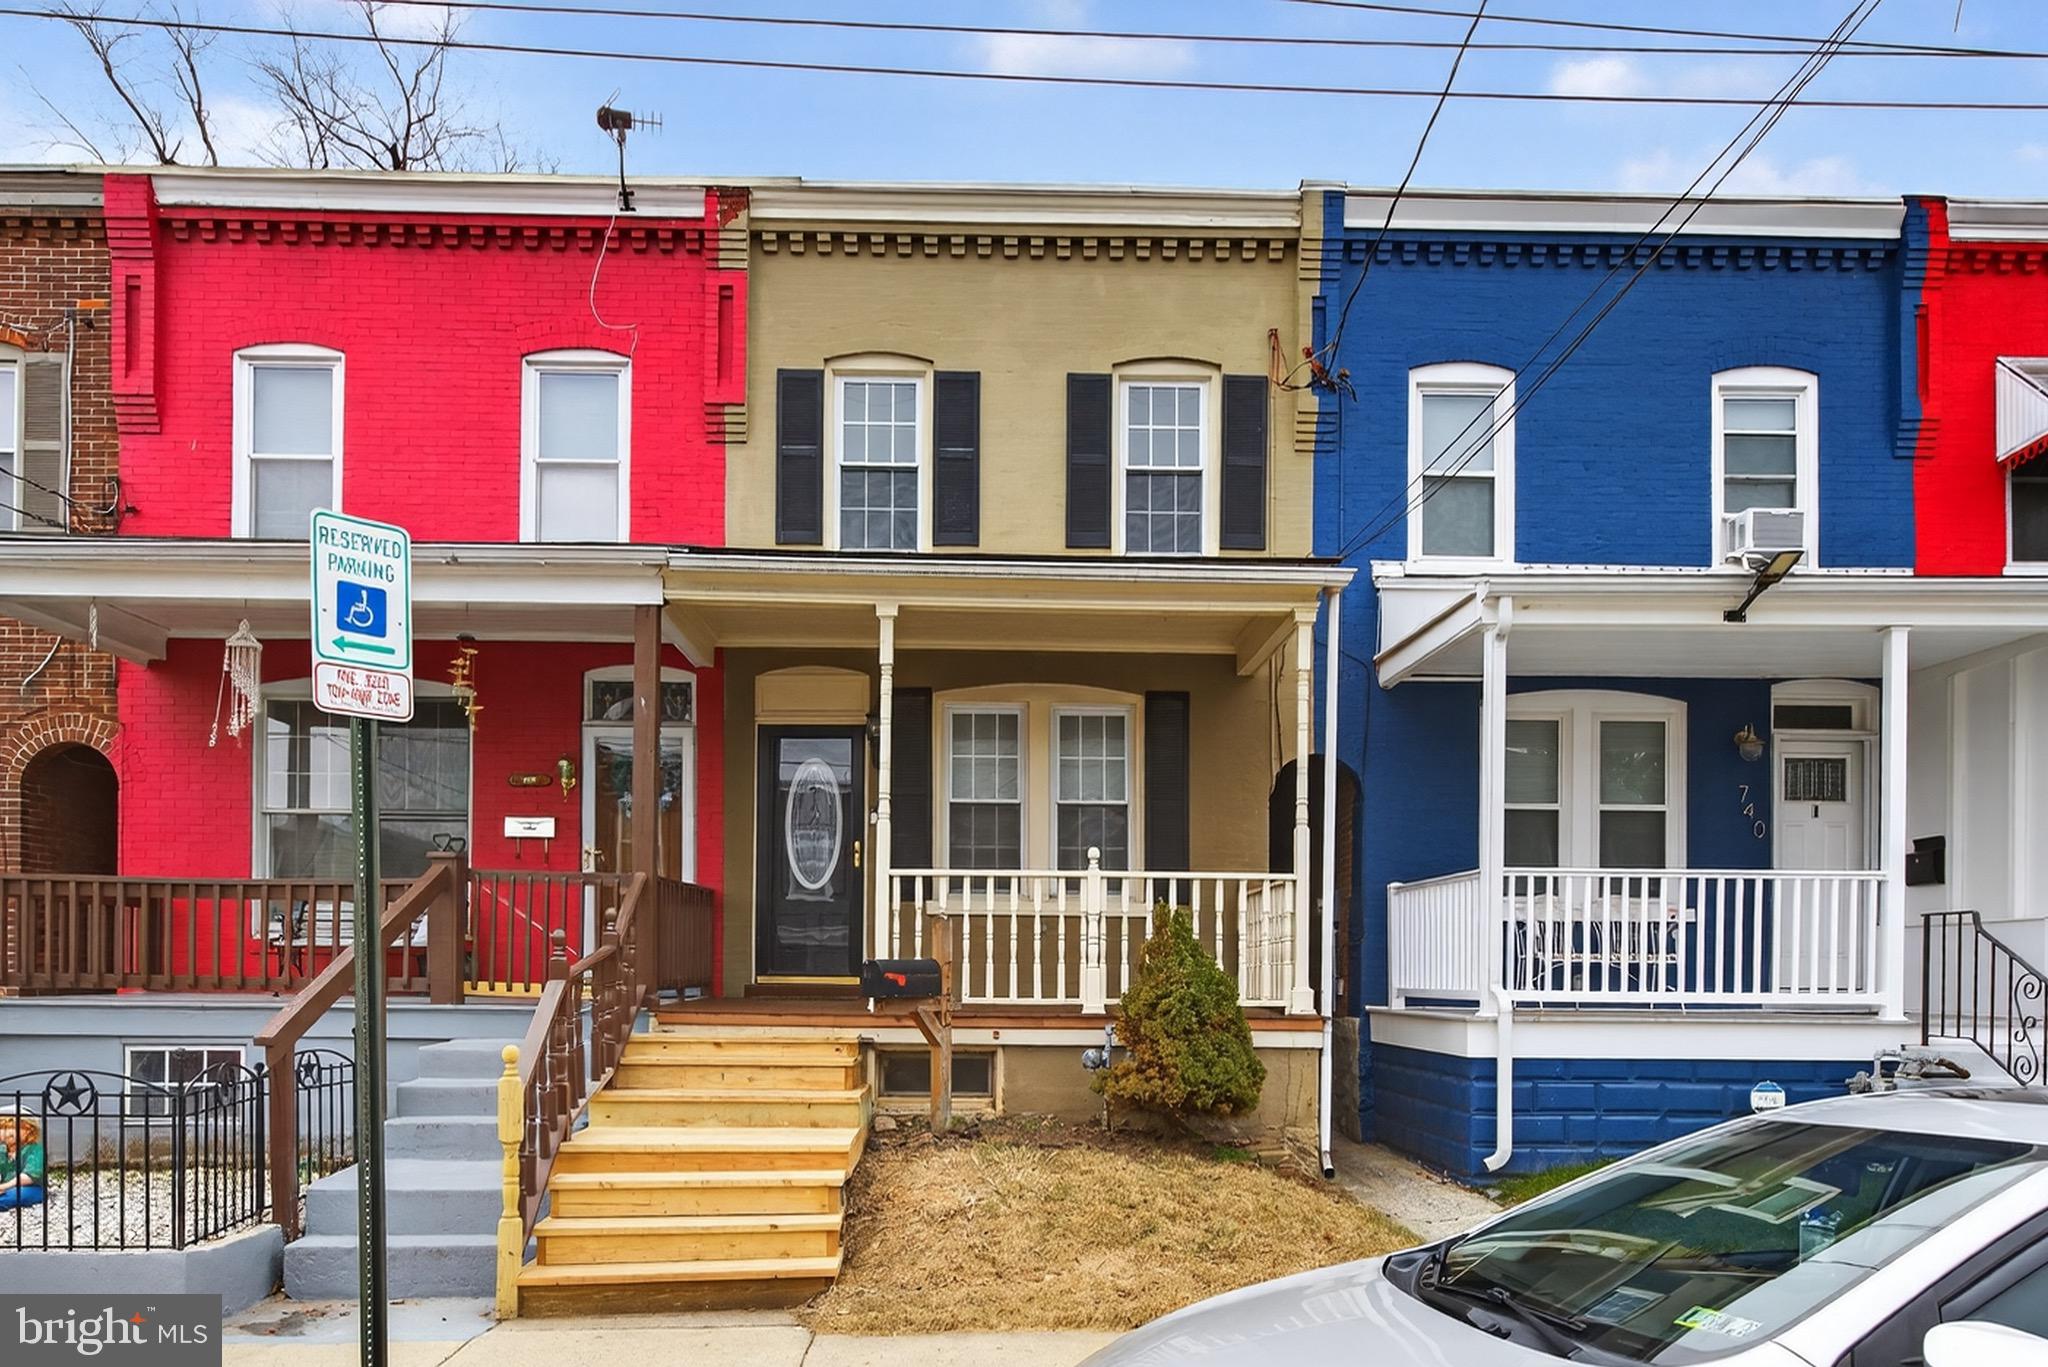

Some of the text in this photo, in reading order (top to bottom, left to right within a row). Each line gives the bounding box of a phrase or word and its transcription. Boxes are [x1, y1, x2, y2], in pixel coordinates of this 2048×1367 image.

[319, 525, 401, 559] RESERVED
[328, 552, 395, 583] PARKING
[1738, 784, 1766, 839] 740
